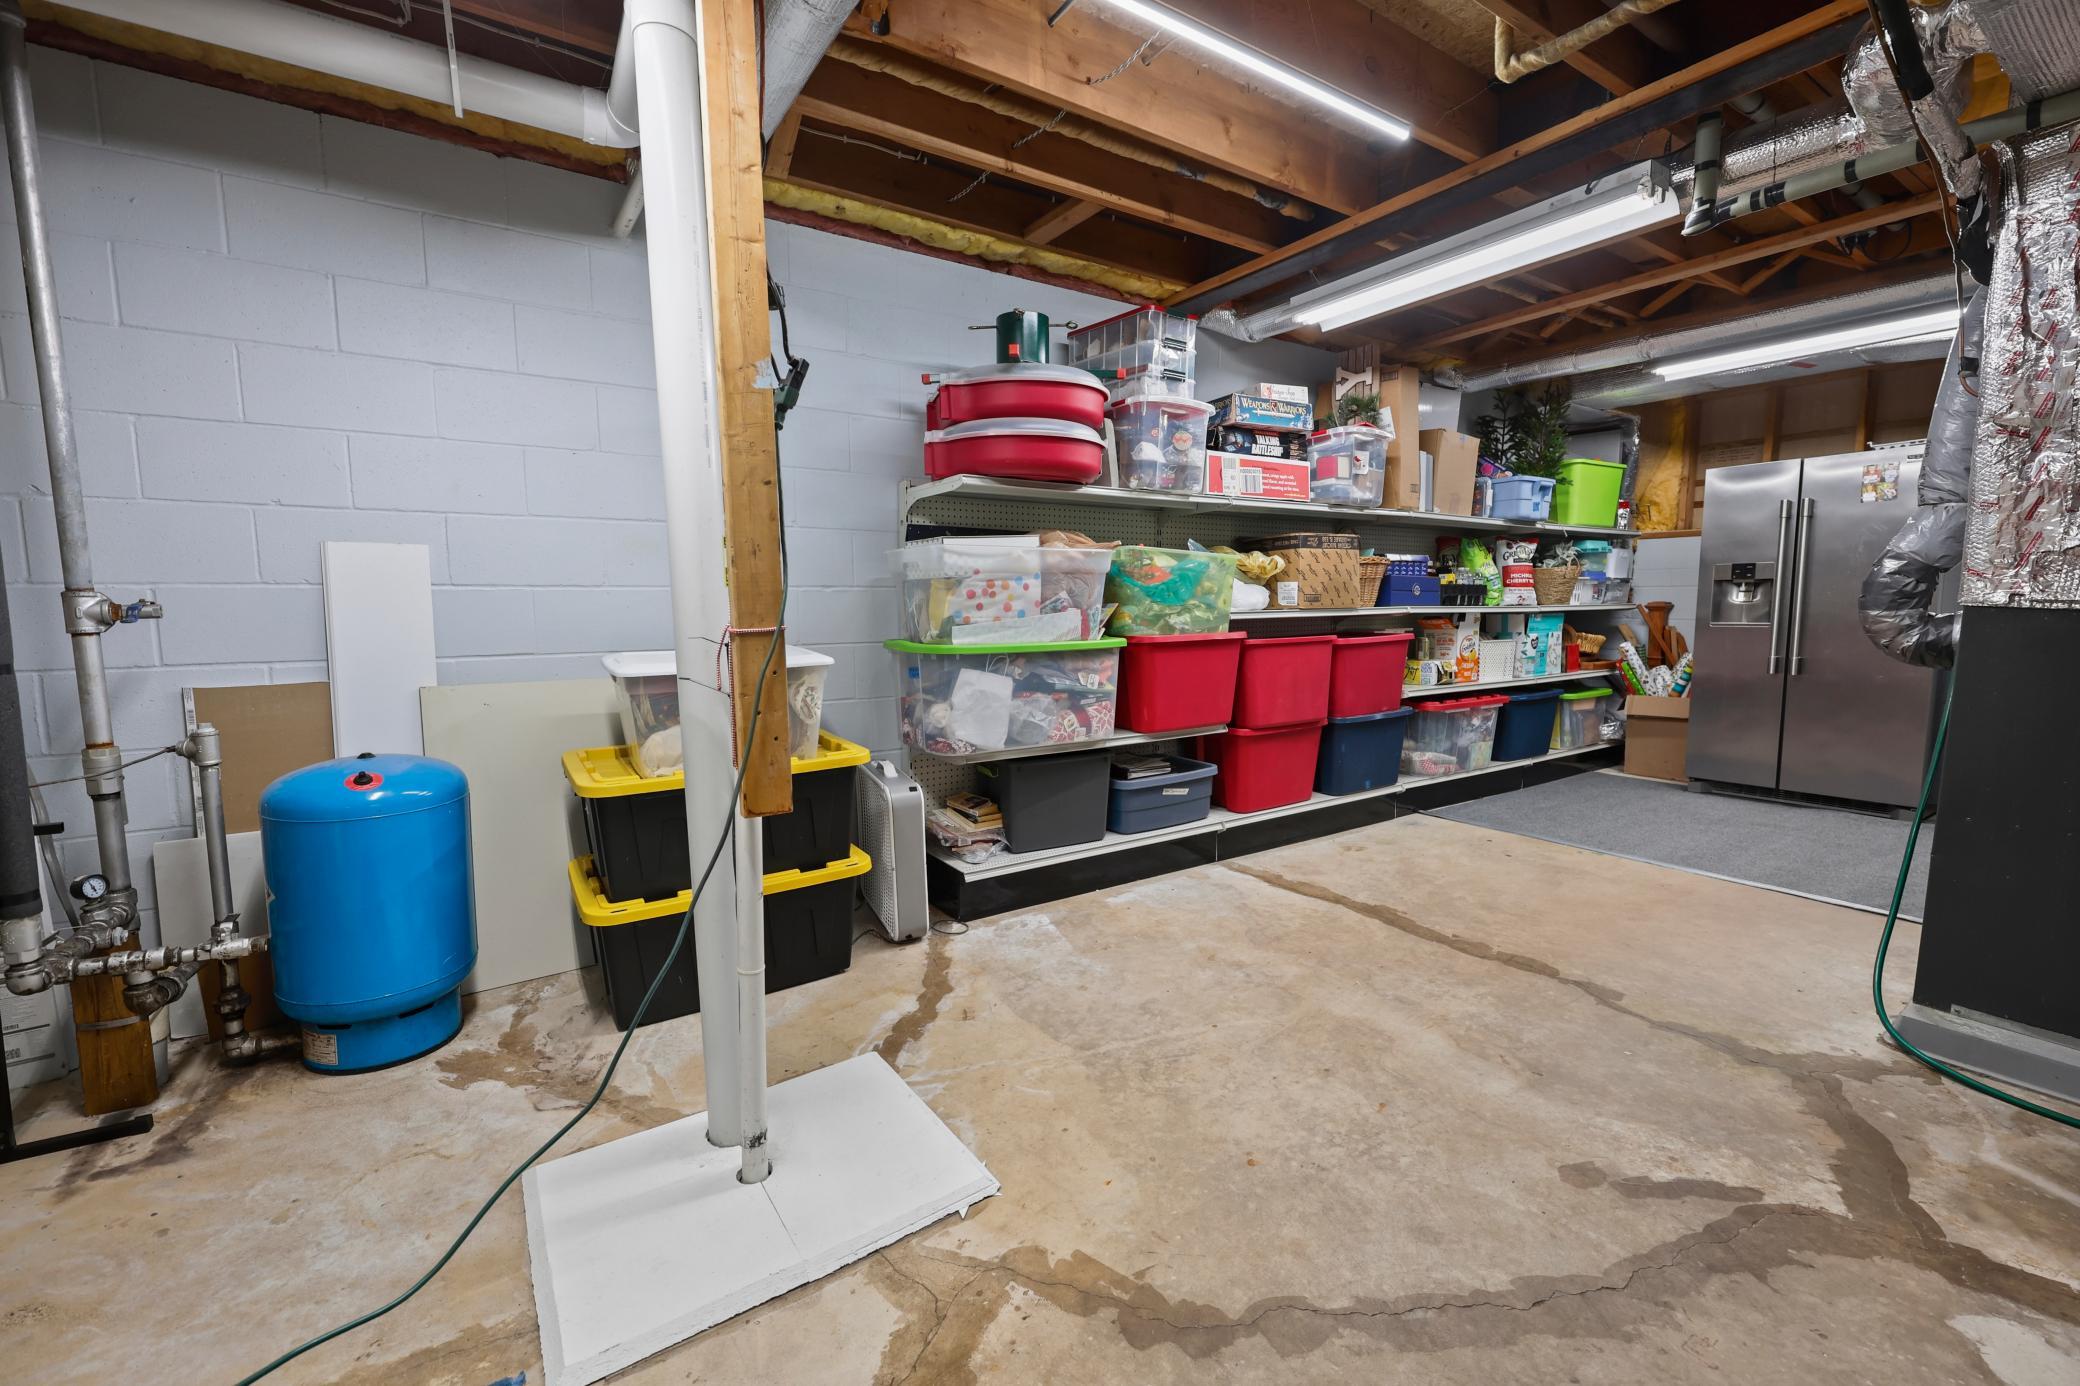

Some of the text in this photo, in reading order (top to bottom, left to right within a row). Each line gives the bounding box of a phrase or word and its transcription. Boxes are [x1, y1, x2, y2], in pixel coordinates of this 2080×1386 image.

[1241, 397, 1270, 410] WEAPONS
[1278, 402, 1307, 415] WARRIORS
[1255, 434, 1281, 446] TALKING
[1251, 443, 1284, 457] BATTLESHIP
